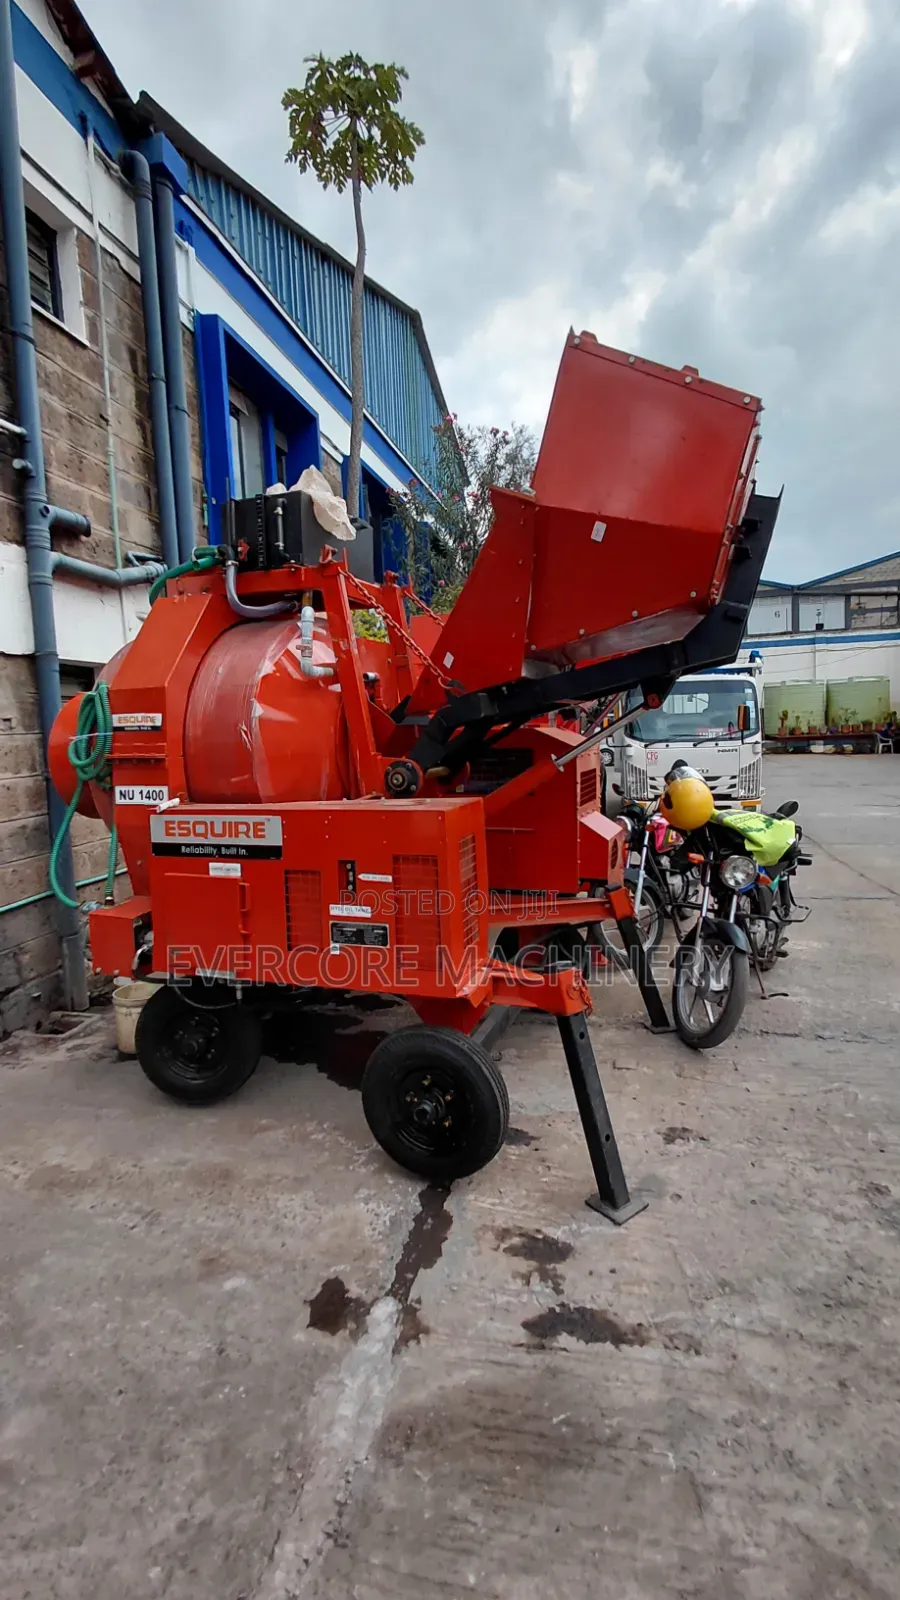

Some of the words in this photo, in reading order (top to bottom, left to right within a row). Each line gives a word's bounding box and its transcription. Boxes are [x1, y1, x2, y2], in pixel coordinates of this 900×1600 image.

[117, 715, 157, 725] ESQUIRE
[119, 789, 135, 801] NU
[138, 789, 165, 801] 1400
[164, 820, 266, 840] ESQUIRE
[221, 846, 237, 855] Built
[238, 847, 249, 856] In.
